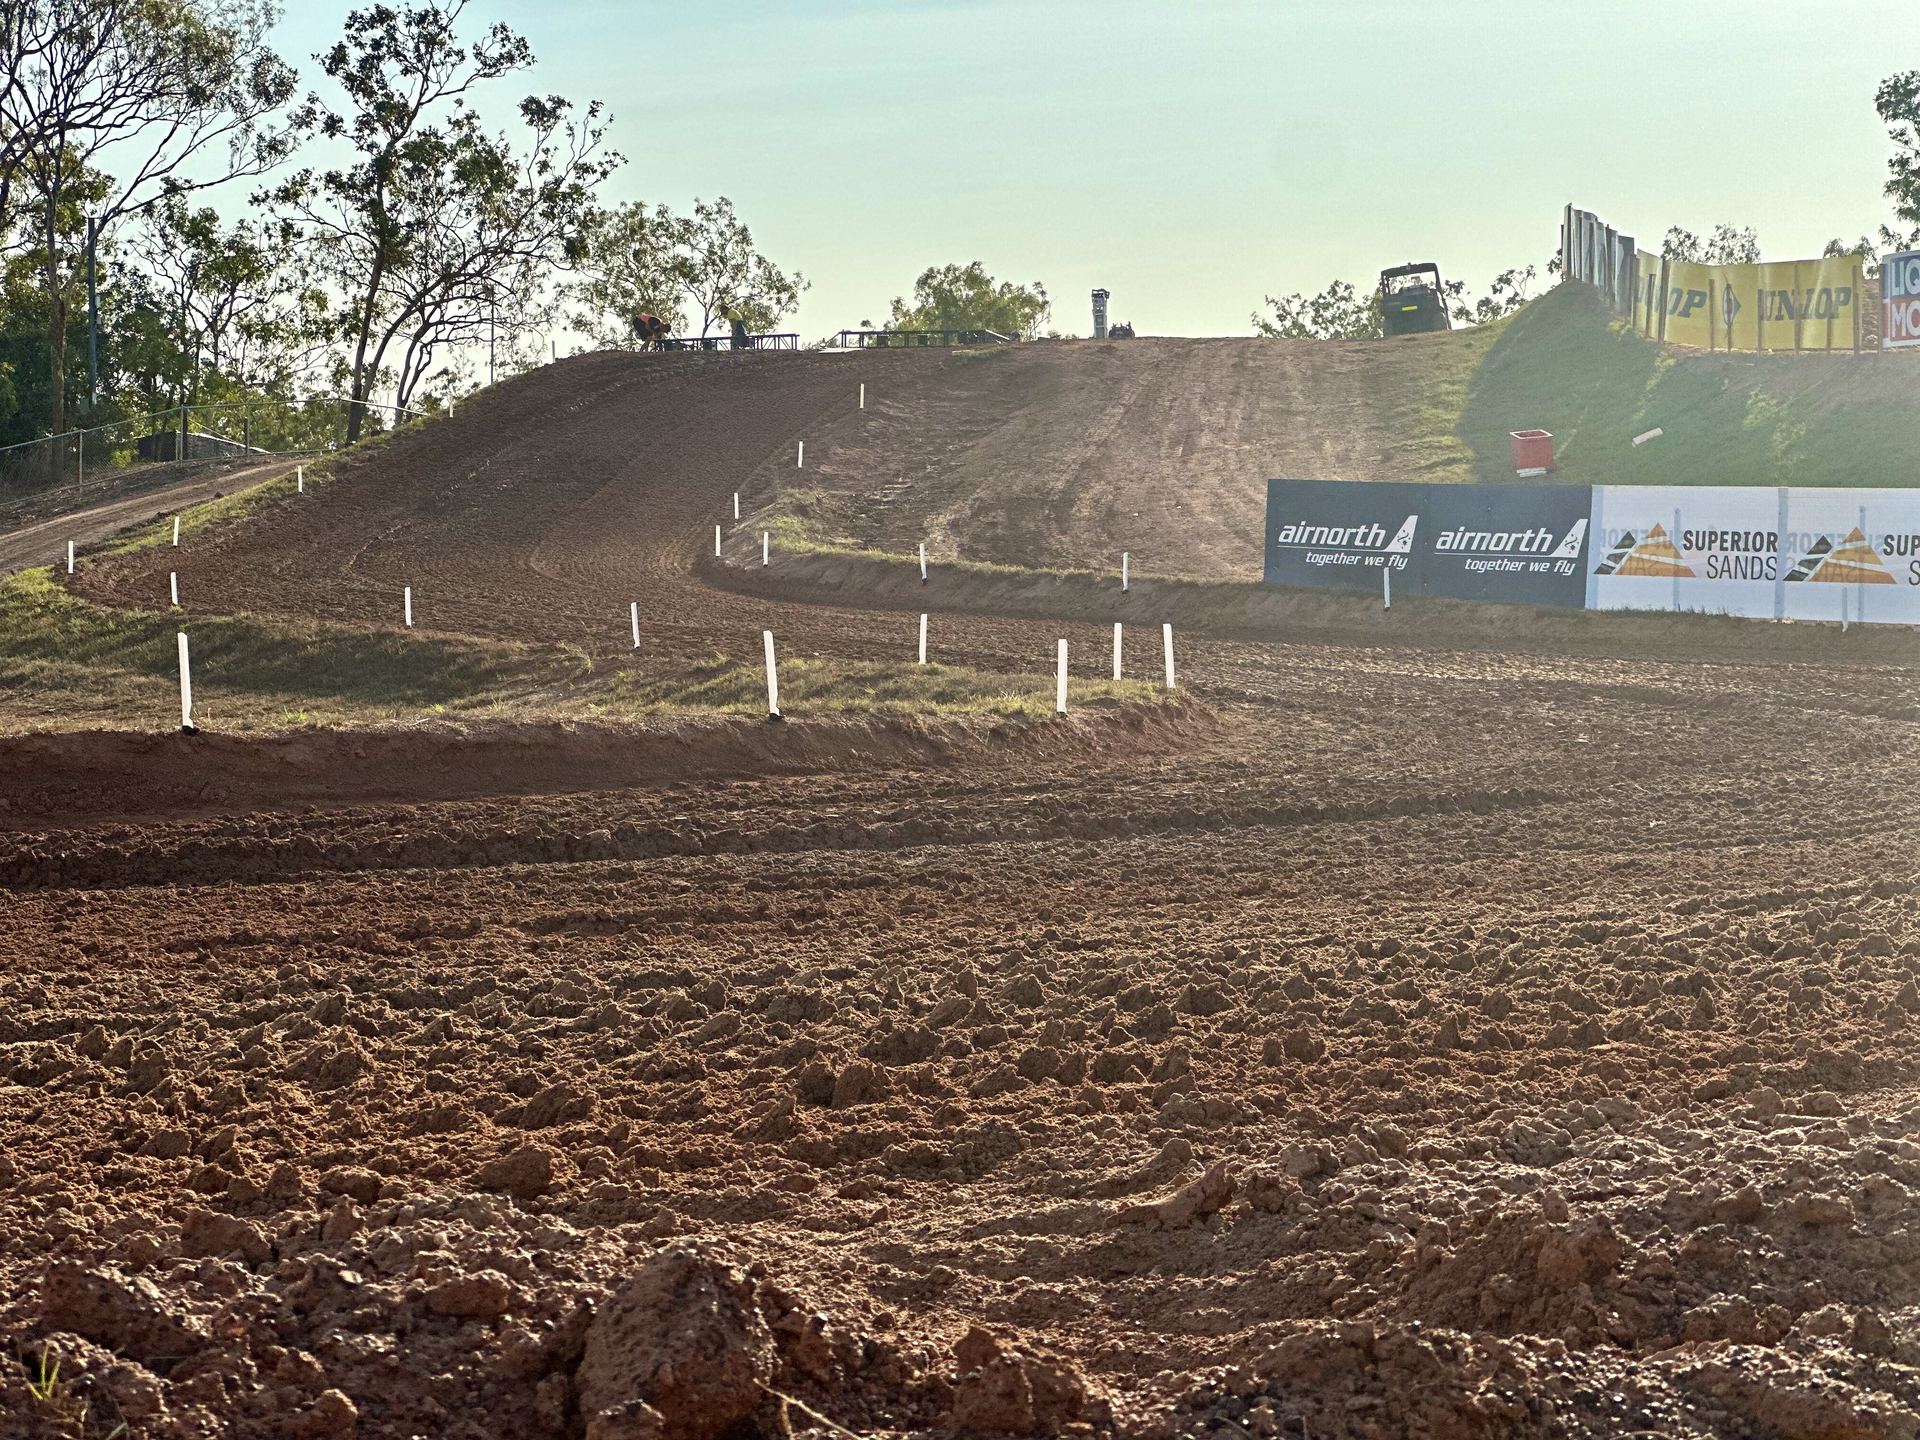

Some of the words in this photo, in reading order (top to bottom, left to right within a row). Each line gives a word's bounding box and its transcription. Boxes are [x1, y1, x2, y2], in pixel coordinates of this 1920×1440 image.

[1278, 521, 1386, 547] airnorth
[1435, 526, 1553, 552] airnorth
[1683, 530, 1778, 552] SUPERIOR
[1306, 551, 1361, 566] together
[1364, 555, 1384, 567] we
[1388, 554, 1408, 570] fly
[1464, 558, 1526, 573] together
[1529, 561, 1550, 573] we
[1553, 559, 1576, 576] fly
[1706, 554, 1777, 581] SANDS
